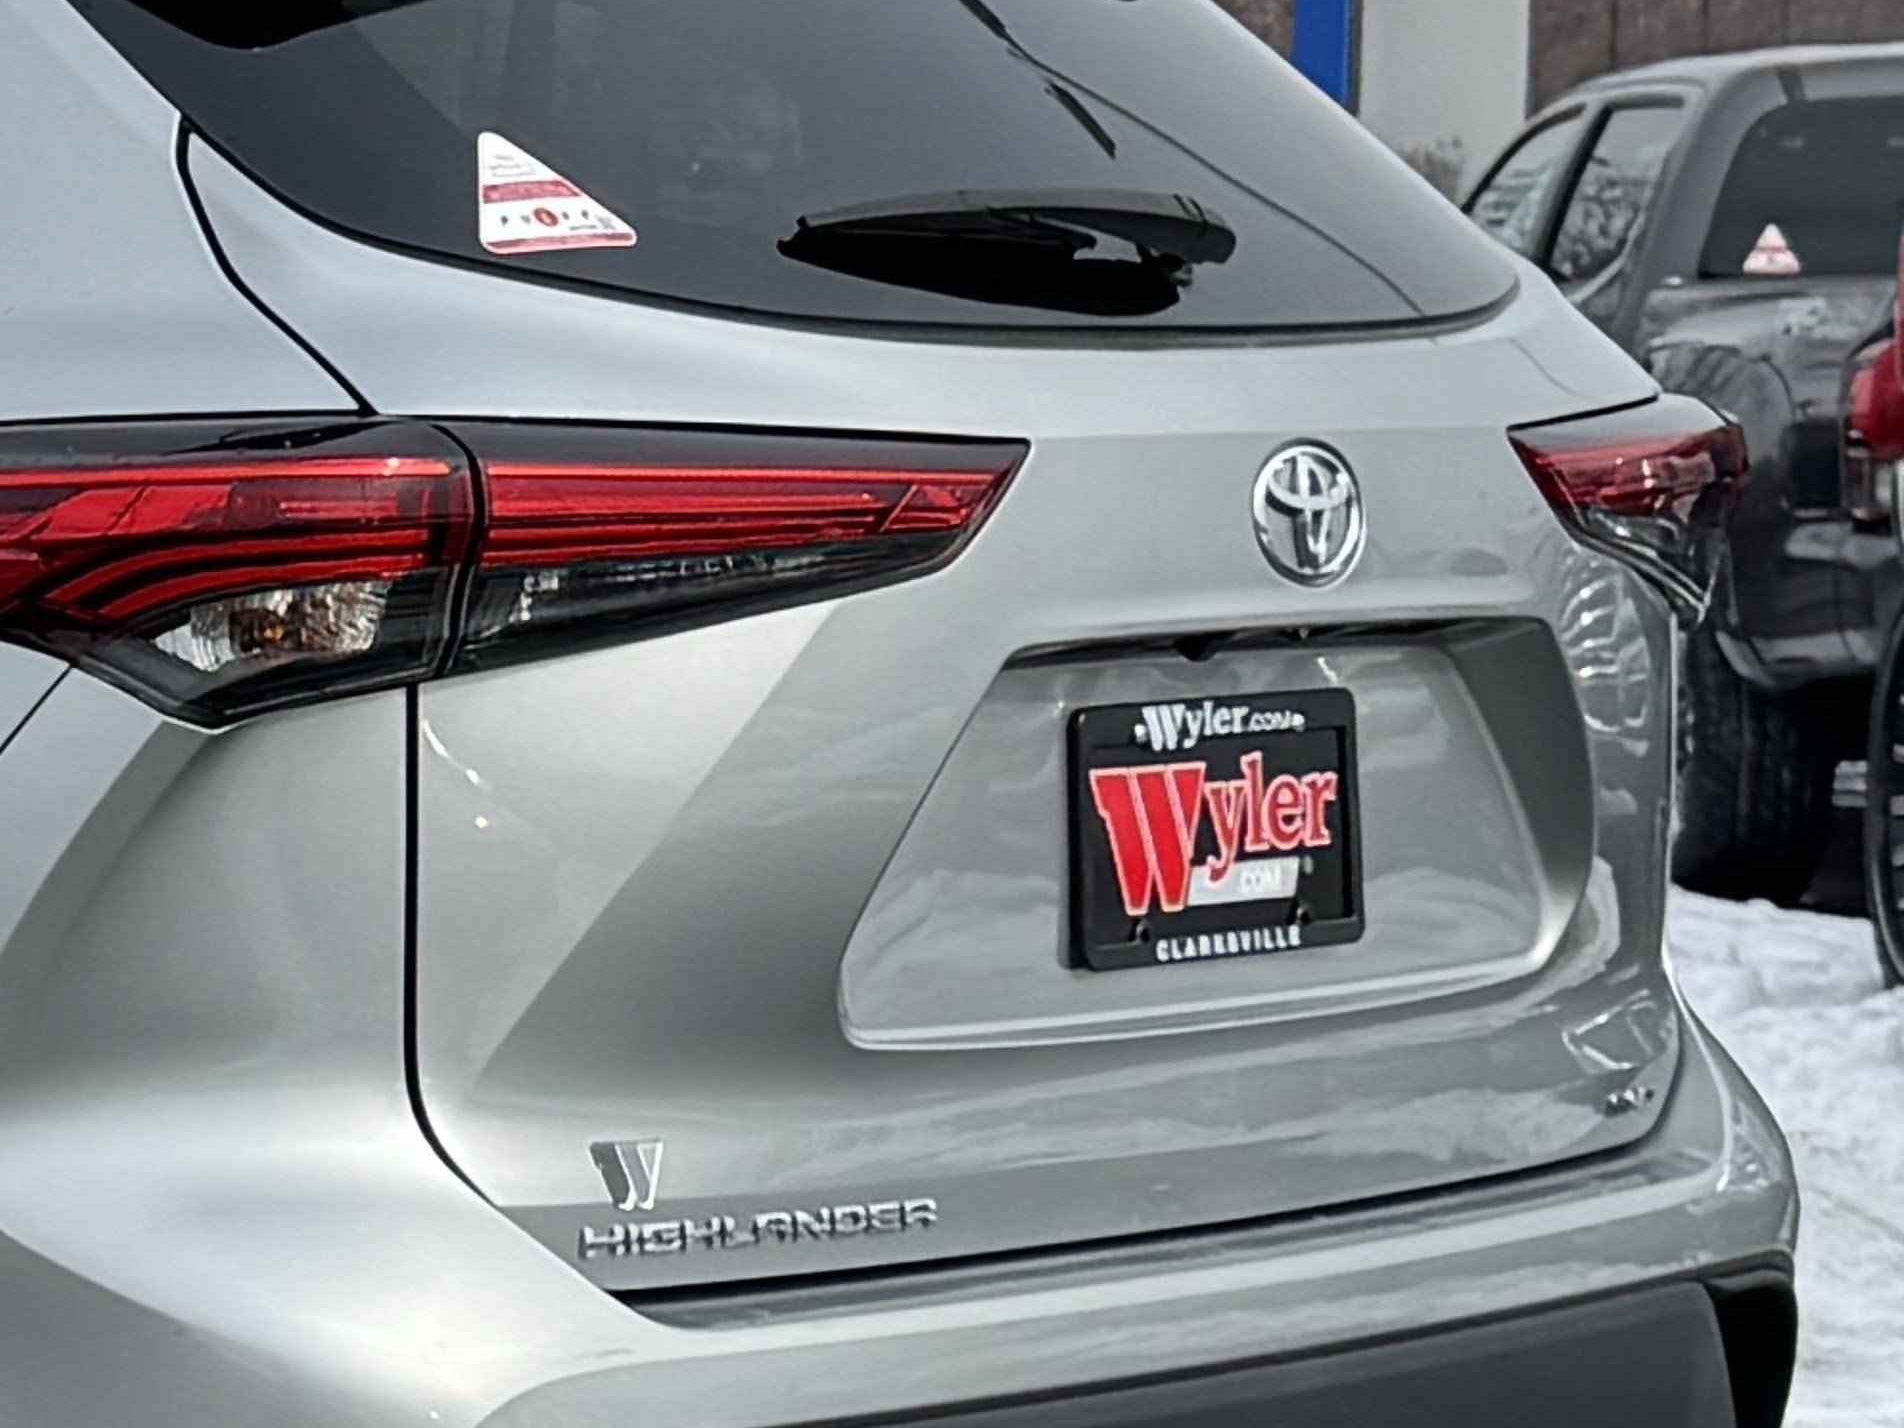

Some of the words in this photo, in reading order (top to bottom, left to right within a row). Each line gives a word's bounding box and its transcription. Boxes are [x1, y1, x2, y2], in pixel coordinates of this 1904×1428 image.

[1089, 750, 1338, 917] Wyler
[1156, 925, 1301, 962] CLARKSVILLE
[578, 1197, 940, 1259] HIGHLANDER
